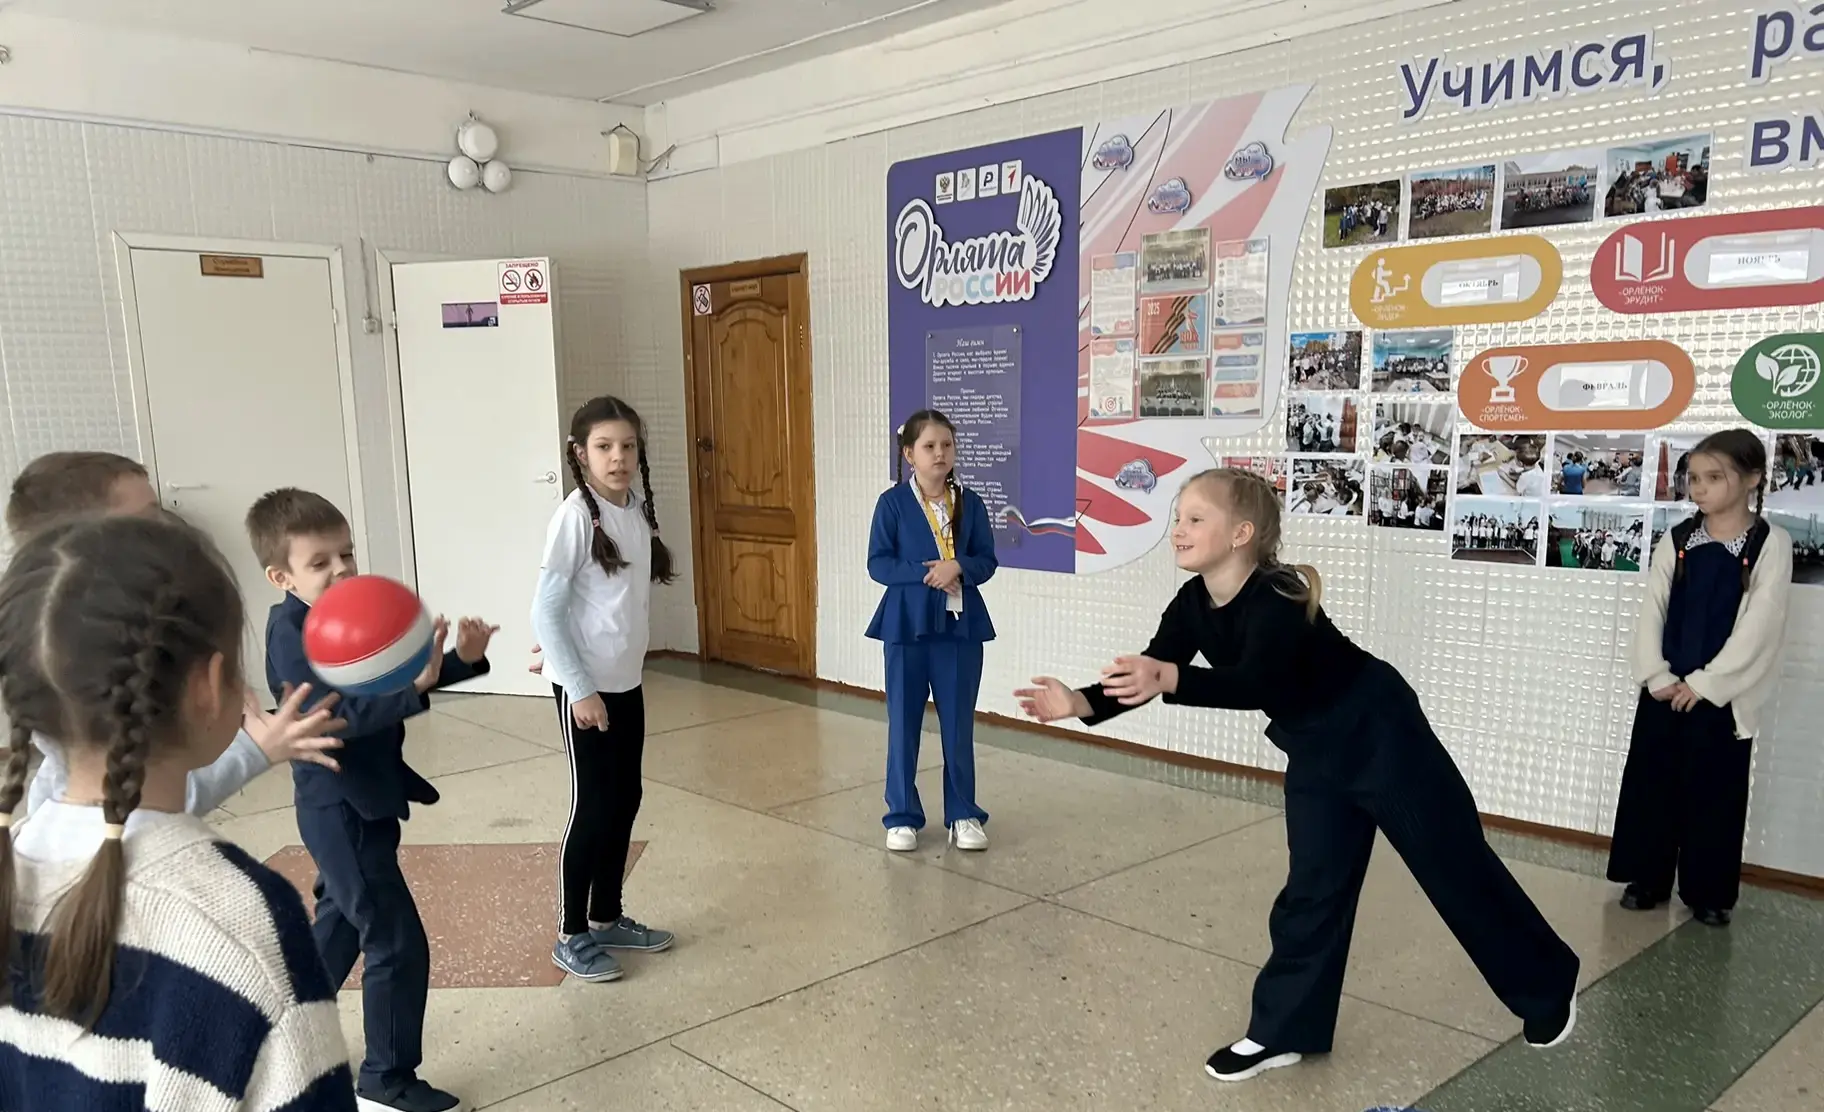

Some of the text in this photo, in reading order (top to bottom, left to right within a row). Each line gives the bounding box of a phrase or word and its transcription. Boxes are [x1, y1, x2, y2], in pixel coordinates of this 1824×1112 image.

[1400, 33, 1665, 119] Учимся,
[900, 204, 1026, 297] Орлята
[1738, 254, 1780, 264] НОЯЬ
[934, 269, 1031, 301] РОССИИ
[1582, 382, 1628, 391] ФЕВРАЛЬ
